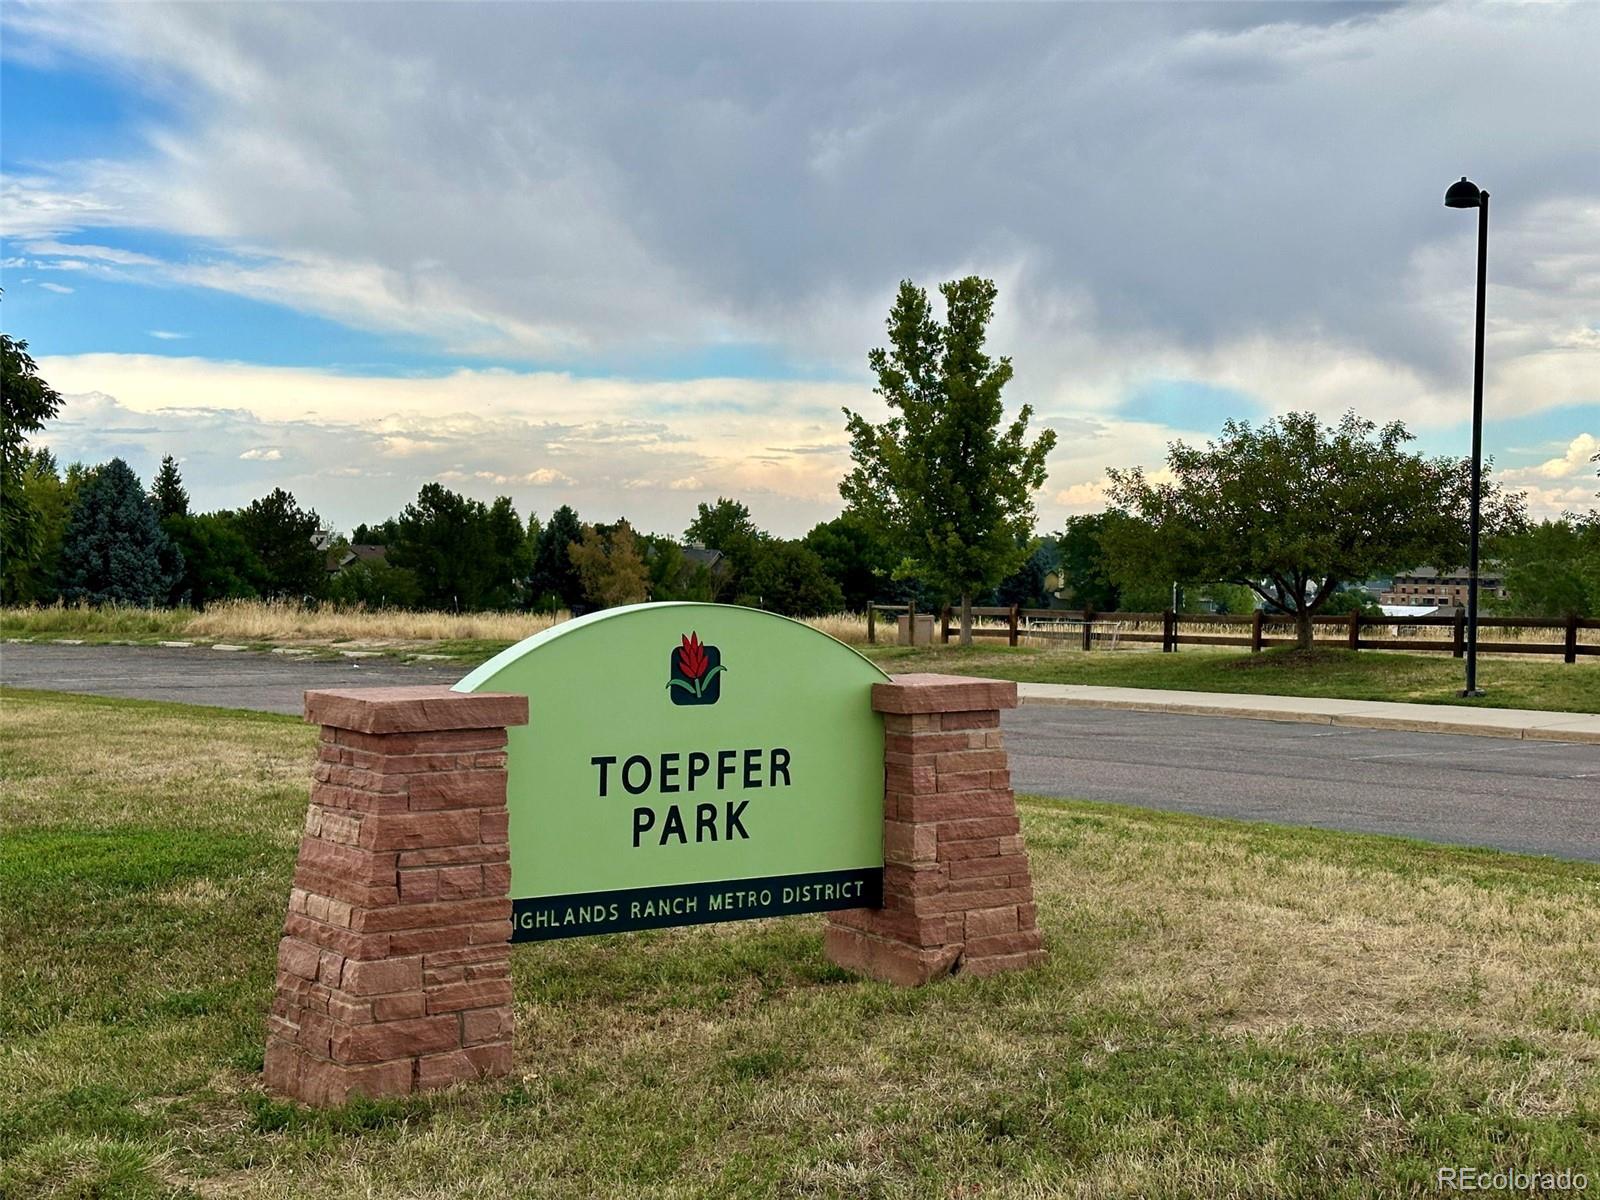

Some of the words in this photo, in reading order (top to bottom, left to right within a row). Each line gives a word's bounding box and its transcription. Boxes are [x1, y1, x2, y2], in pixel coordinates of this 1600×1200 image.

[591, 747, 792, 797] TOEPFER
[632, 800, 751, 848] PARK
[513, 903, 619, 930] IGHLANDS
[630, 896, 698, 920] RANCH
[708, 889, 772, 911] METRO
[782, 880, 865, 904] DISTRICT
